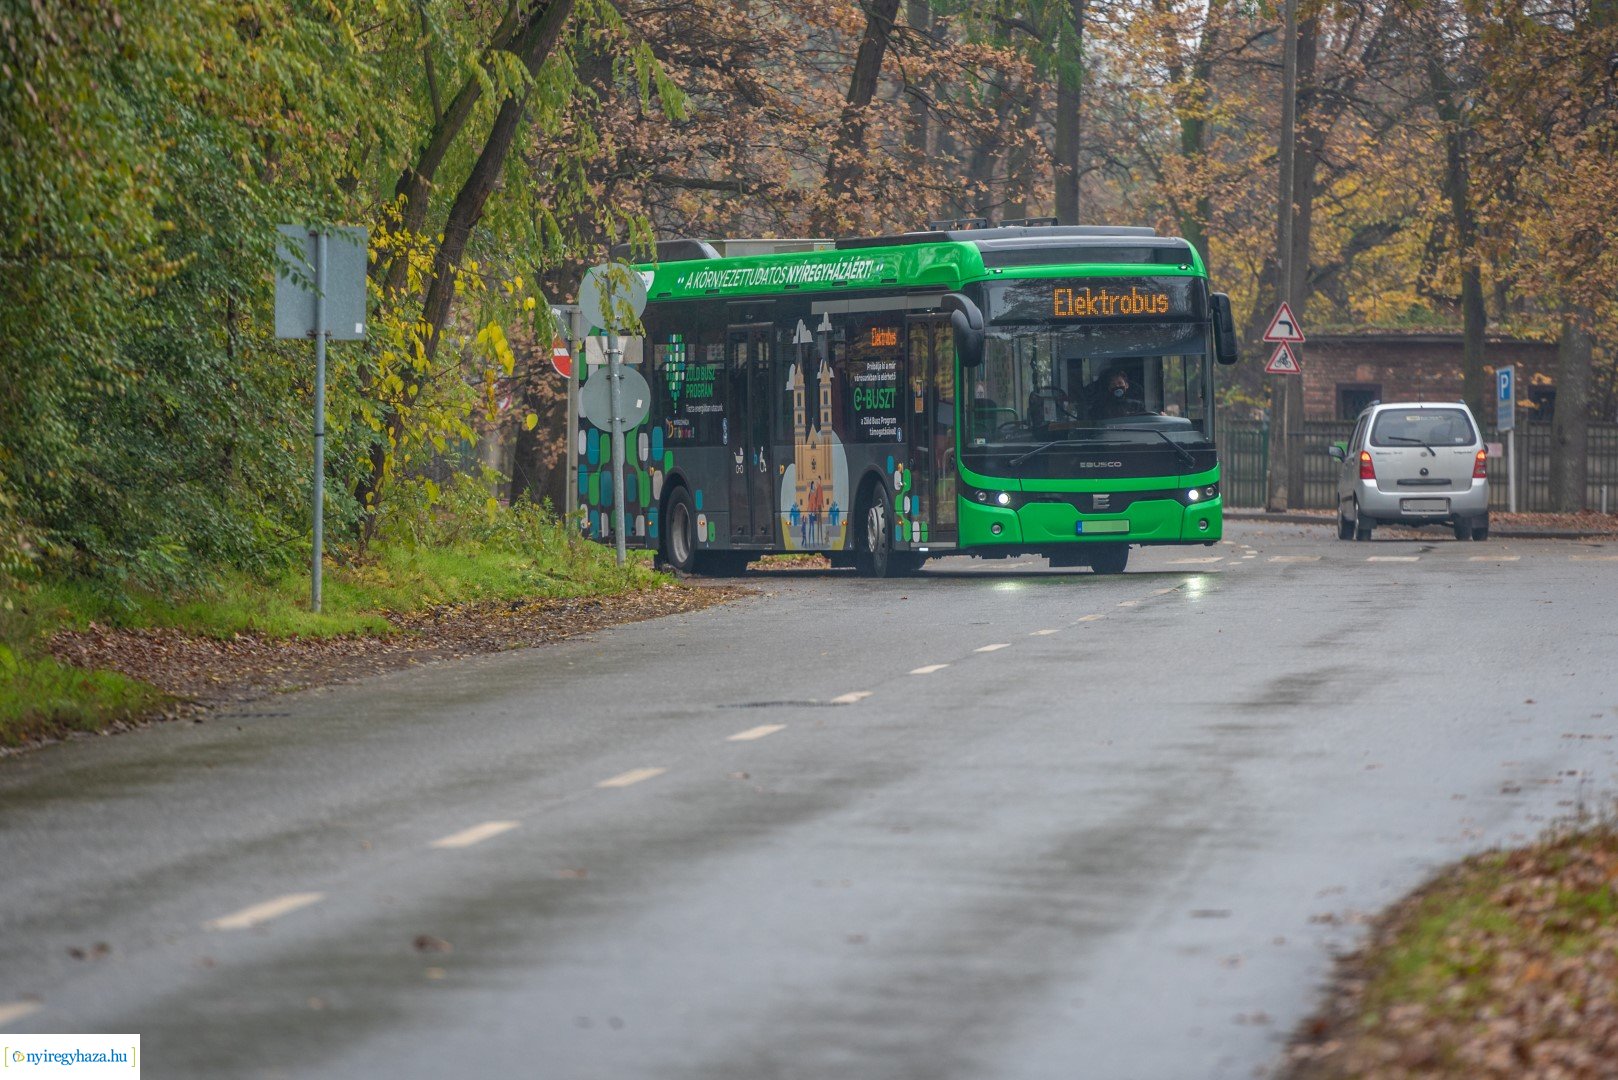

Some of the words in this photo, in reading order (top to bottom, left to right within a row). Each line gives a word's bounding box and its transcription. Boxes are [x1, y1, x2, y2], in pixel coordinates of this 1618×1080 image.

[693, 266, 788, 289] KÖRNYEZETTUDATOS
[785, 256, 874, 284] NYÍREGYHÁZÁÉRT!
[1054, 286, 1169, 316] Elektrobus
[686, 383, 713, 398] PROGRAM
[854, 387, 897, 411] e-BUSZT
